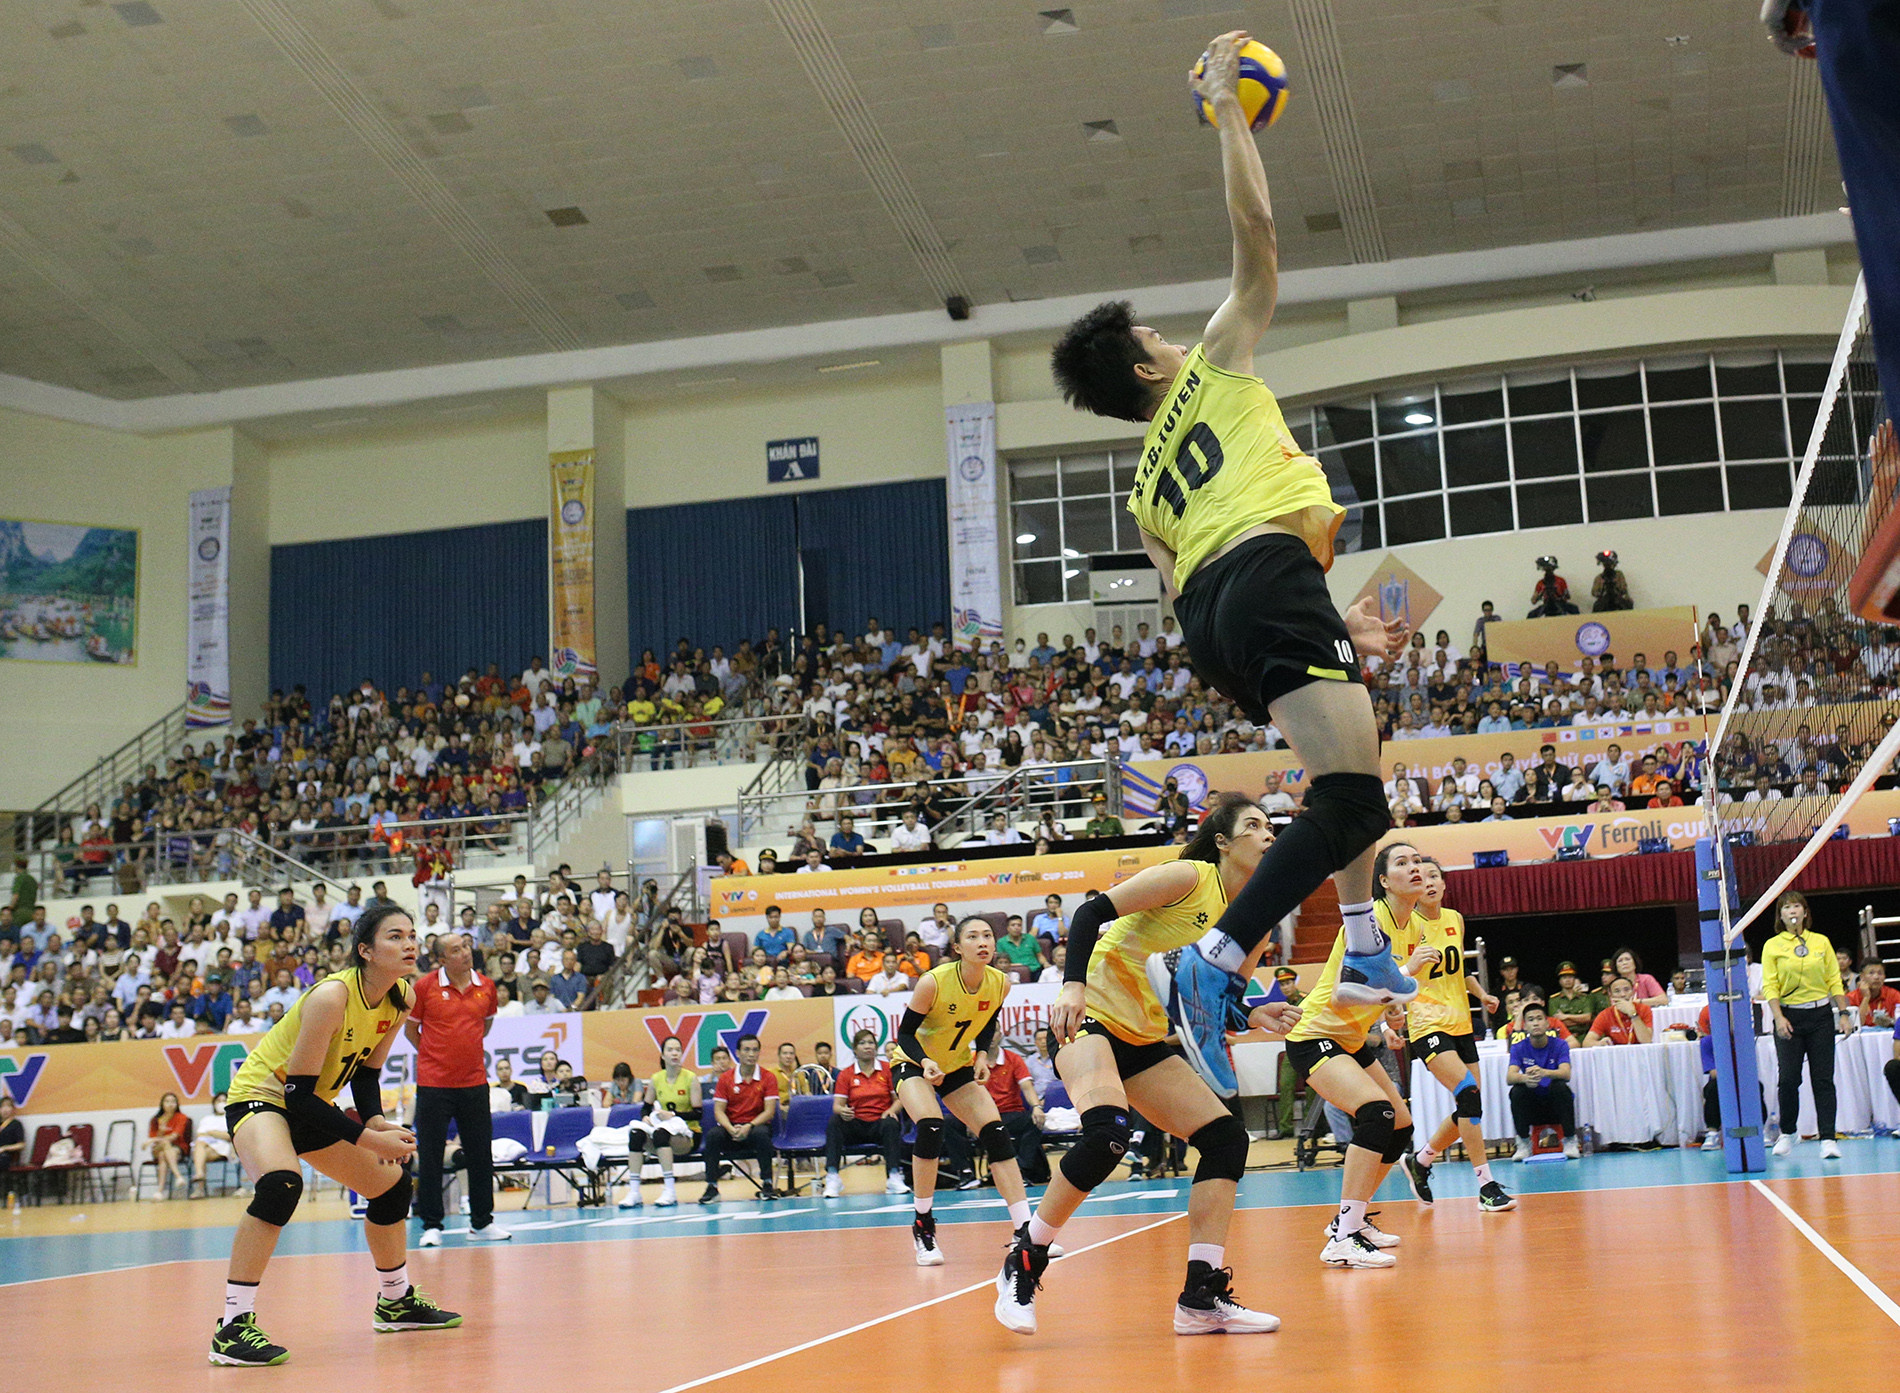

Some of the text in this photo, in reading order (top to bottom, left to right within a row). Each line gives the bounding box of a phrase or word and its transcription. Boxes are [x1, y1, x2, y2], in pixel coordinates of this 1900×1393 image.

[769, 442, 797, 462] KHÁN
[782, 460, 805, 480] A
[1152, 421, 1225, 521] 10
[1333, 639, 1354, 664] 10
[1271, 768, 1305, 784] VTV
[1537, 823, 1596, 850] VTV
[1600, 818, 1663, 849] Ferroli
[721, 891, 744, 902] VTV
[774, 888, 838, 900] INTERNATIONAL
[839, 885, 880, 896] WOMEN'S
[881, 882, 931, 893] VOLLEYBALL
[931, 878, 988, 889] TOURNAMENT
[989, 872, 1013, 884] VTV
[1428, 945, 1461, 980] 20
[1001, 998, 1042, 1044] UYỆT
[643, 1008, 770, 1069] VTV
[948, 1019, 973, 1051] 7
[1318, 1040, 1333, 1053] 15
[1427, 1035, 1440, 1049] 20
